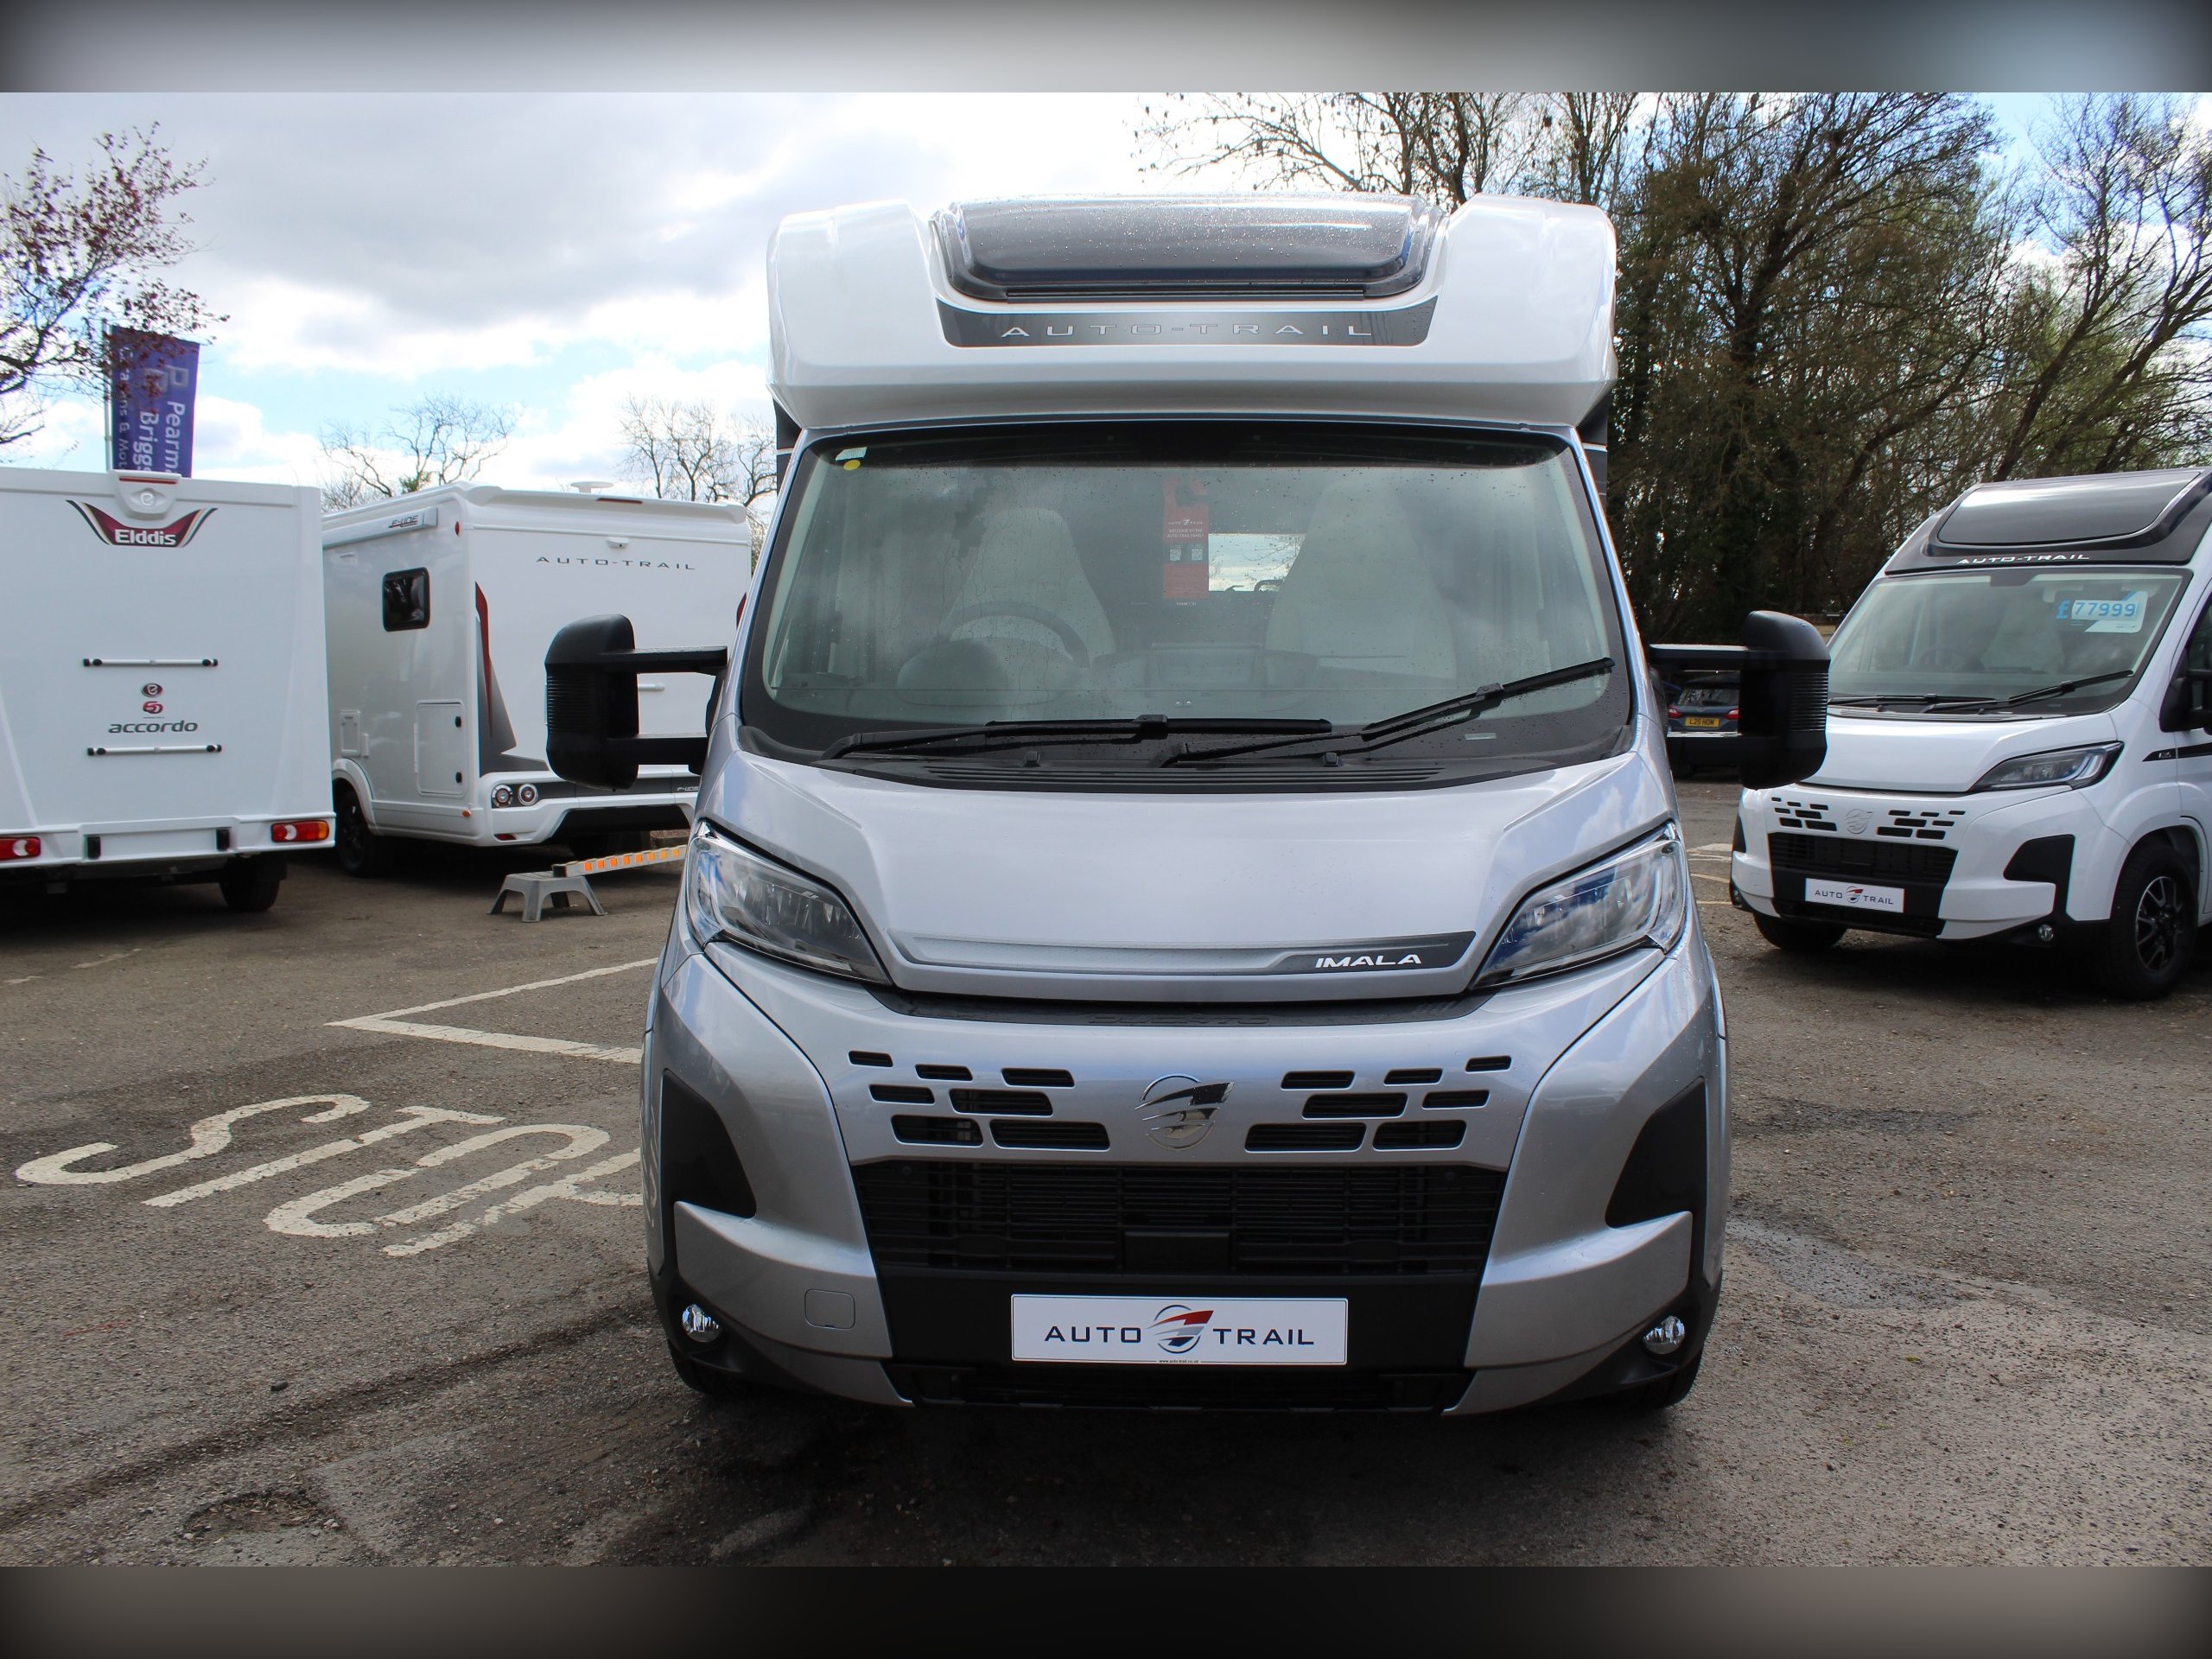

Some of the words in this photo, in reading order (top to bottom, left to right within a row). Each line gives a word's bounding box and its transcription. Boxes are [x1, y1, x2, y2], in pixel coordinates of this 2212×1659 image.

[1001, 323, 1372, 338] AUTO-TRAIL
[114, 529, 177, 545] Elddis
[536, 556, 696, 570] AUTO-TRAIL
[1955, 554, 2090, 565] AUTO-TRAIL
[108, 720, 199, 734] accordo
[1815, 889, 1843, 899] AUTO
[1863, 894, 1894, 905] TRAIL
[1315, 954, 1422, 969] IMALA
[1044, 1325, 1141, 1344] AUTO
[1212, 1327, 1315, 1345] TRAIL
